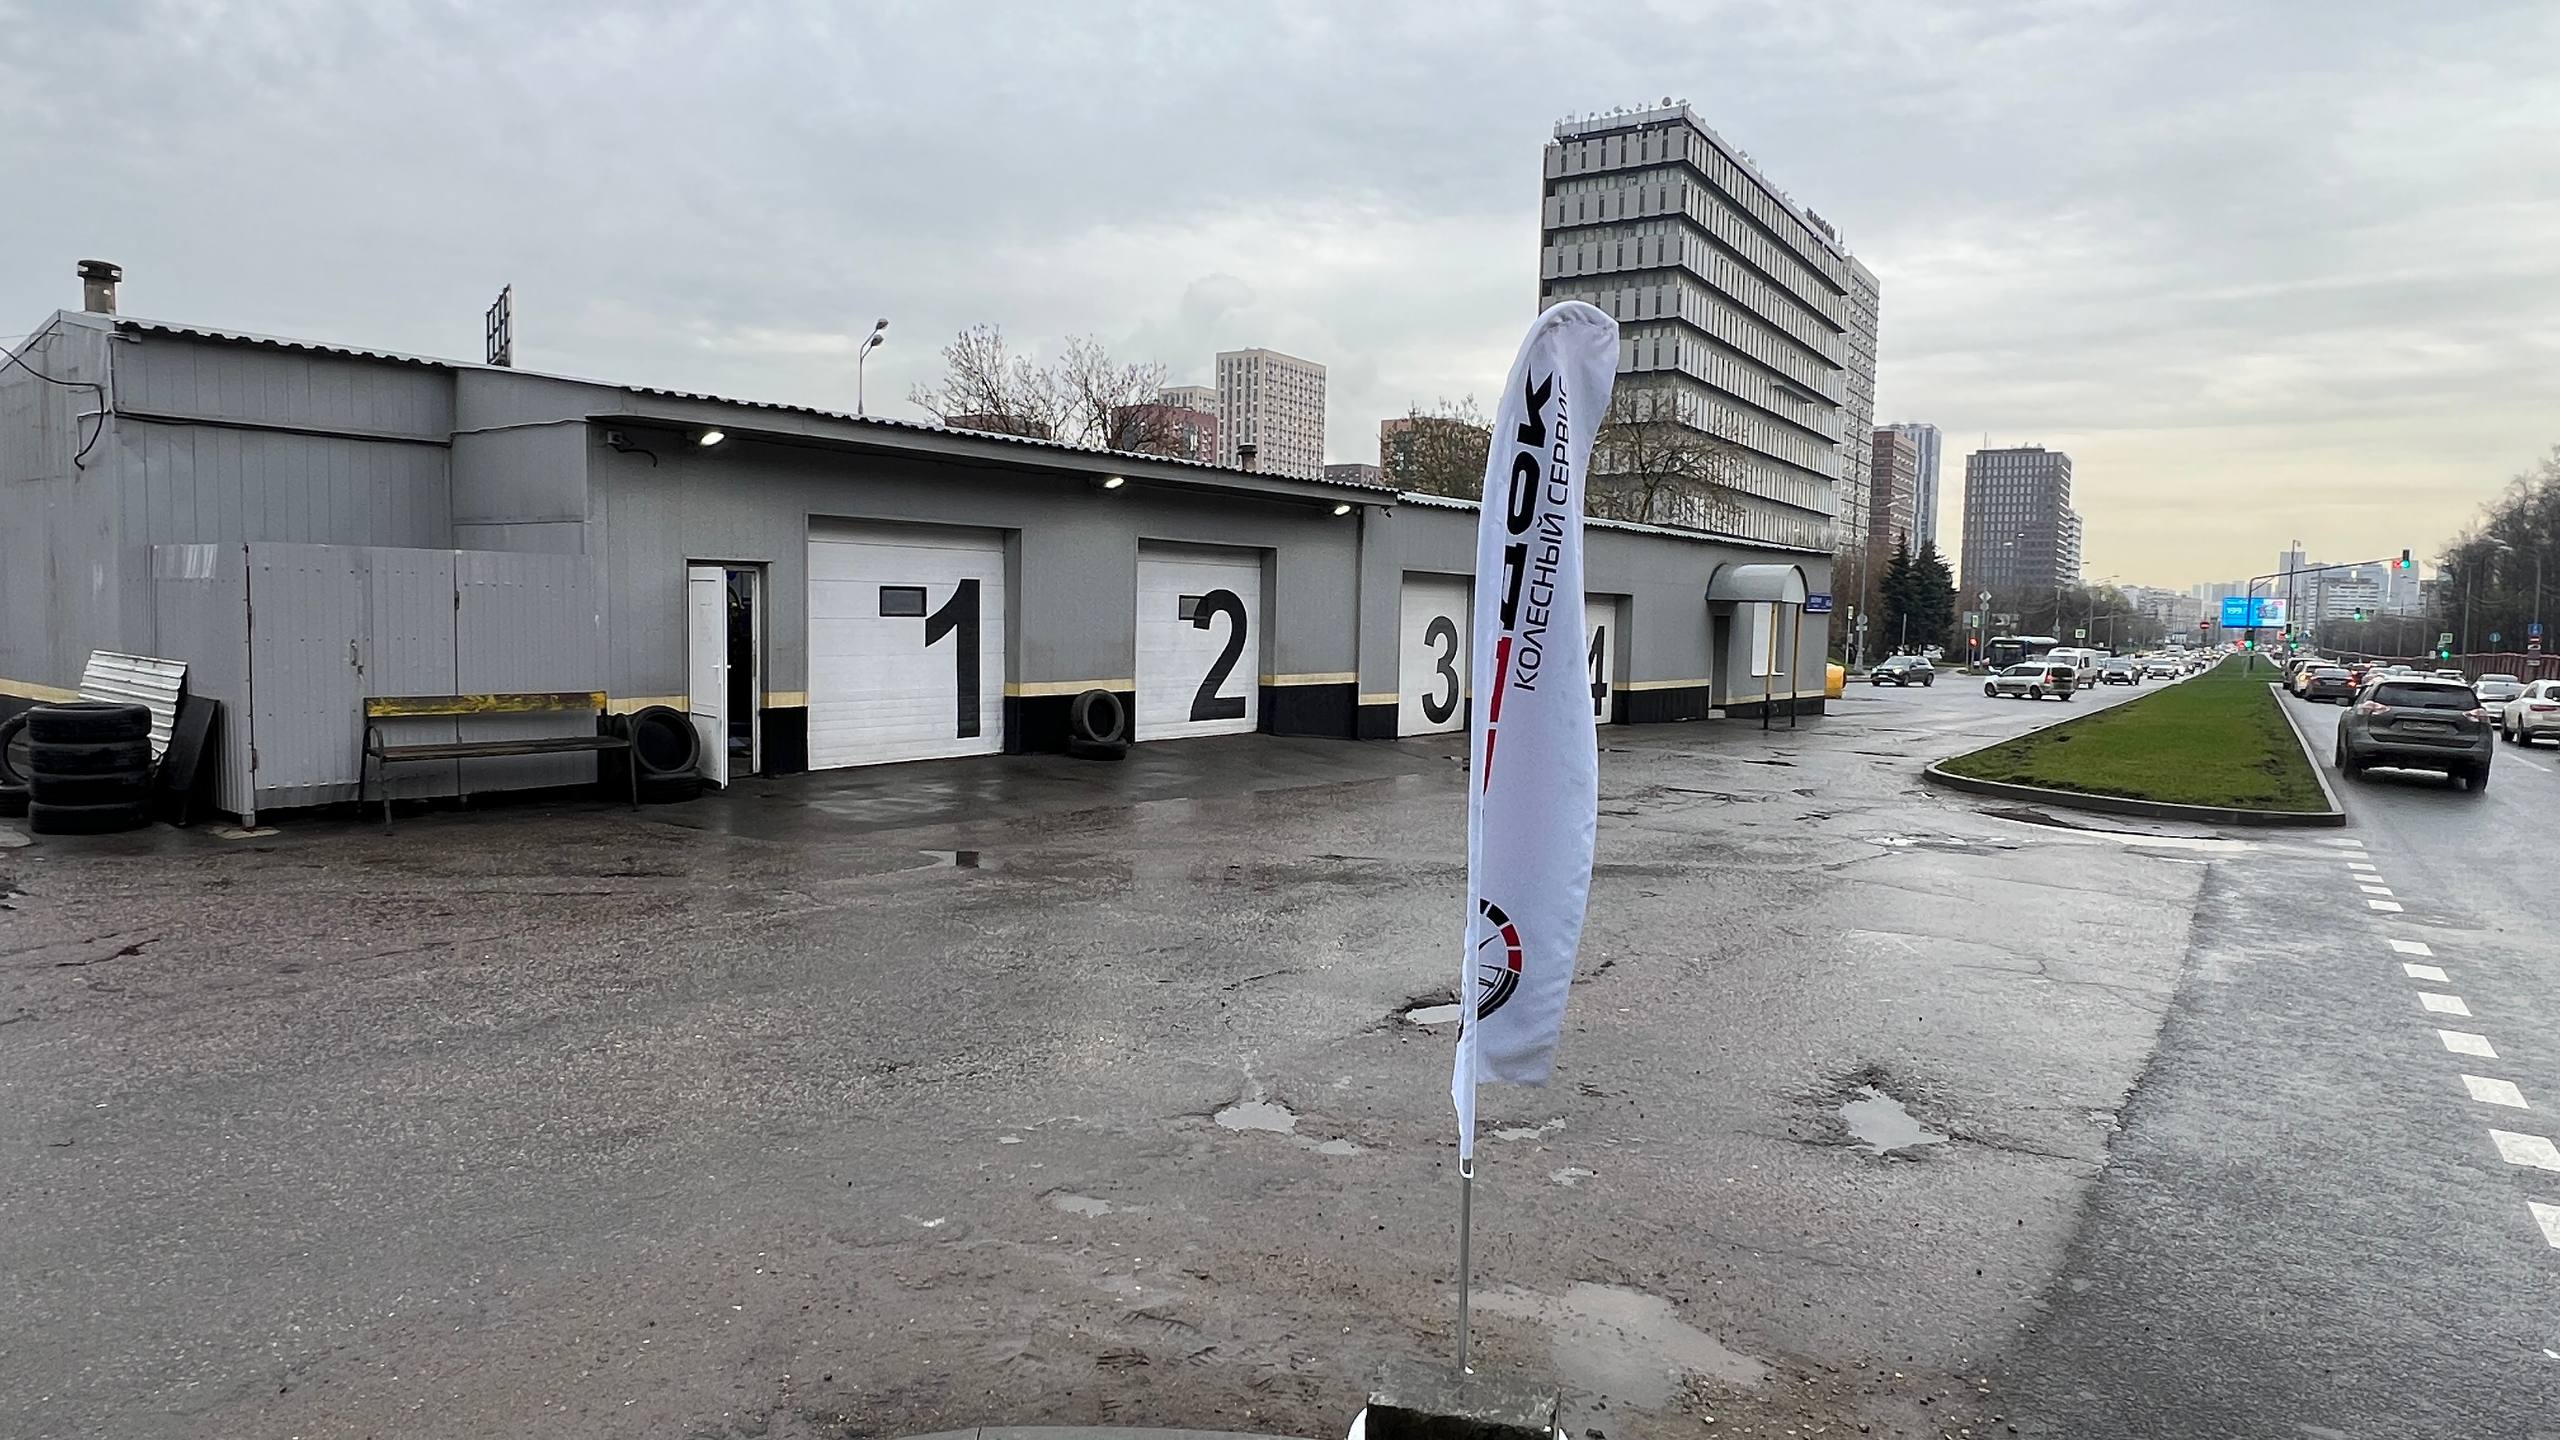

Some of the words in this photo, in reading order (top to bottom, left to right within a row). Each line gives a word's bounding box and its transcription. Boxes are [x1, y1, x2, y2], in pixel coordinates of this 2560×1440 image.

[924, 578, 981, 738] 1
[1190, 589, 1248, 722] 2
[1422, 615, 1459, 725] 3
[1514, 512, 1565, 691] КОЛЕСНЫЙ
